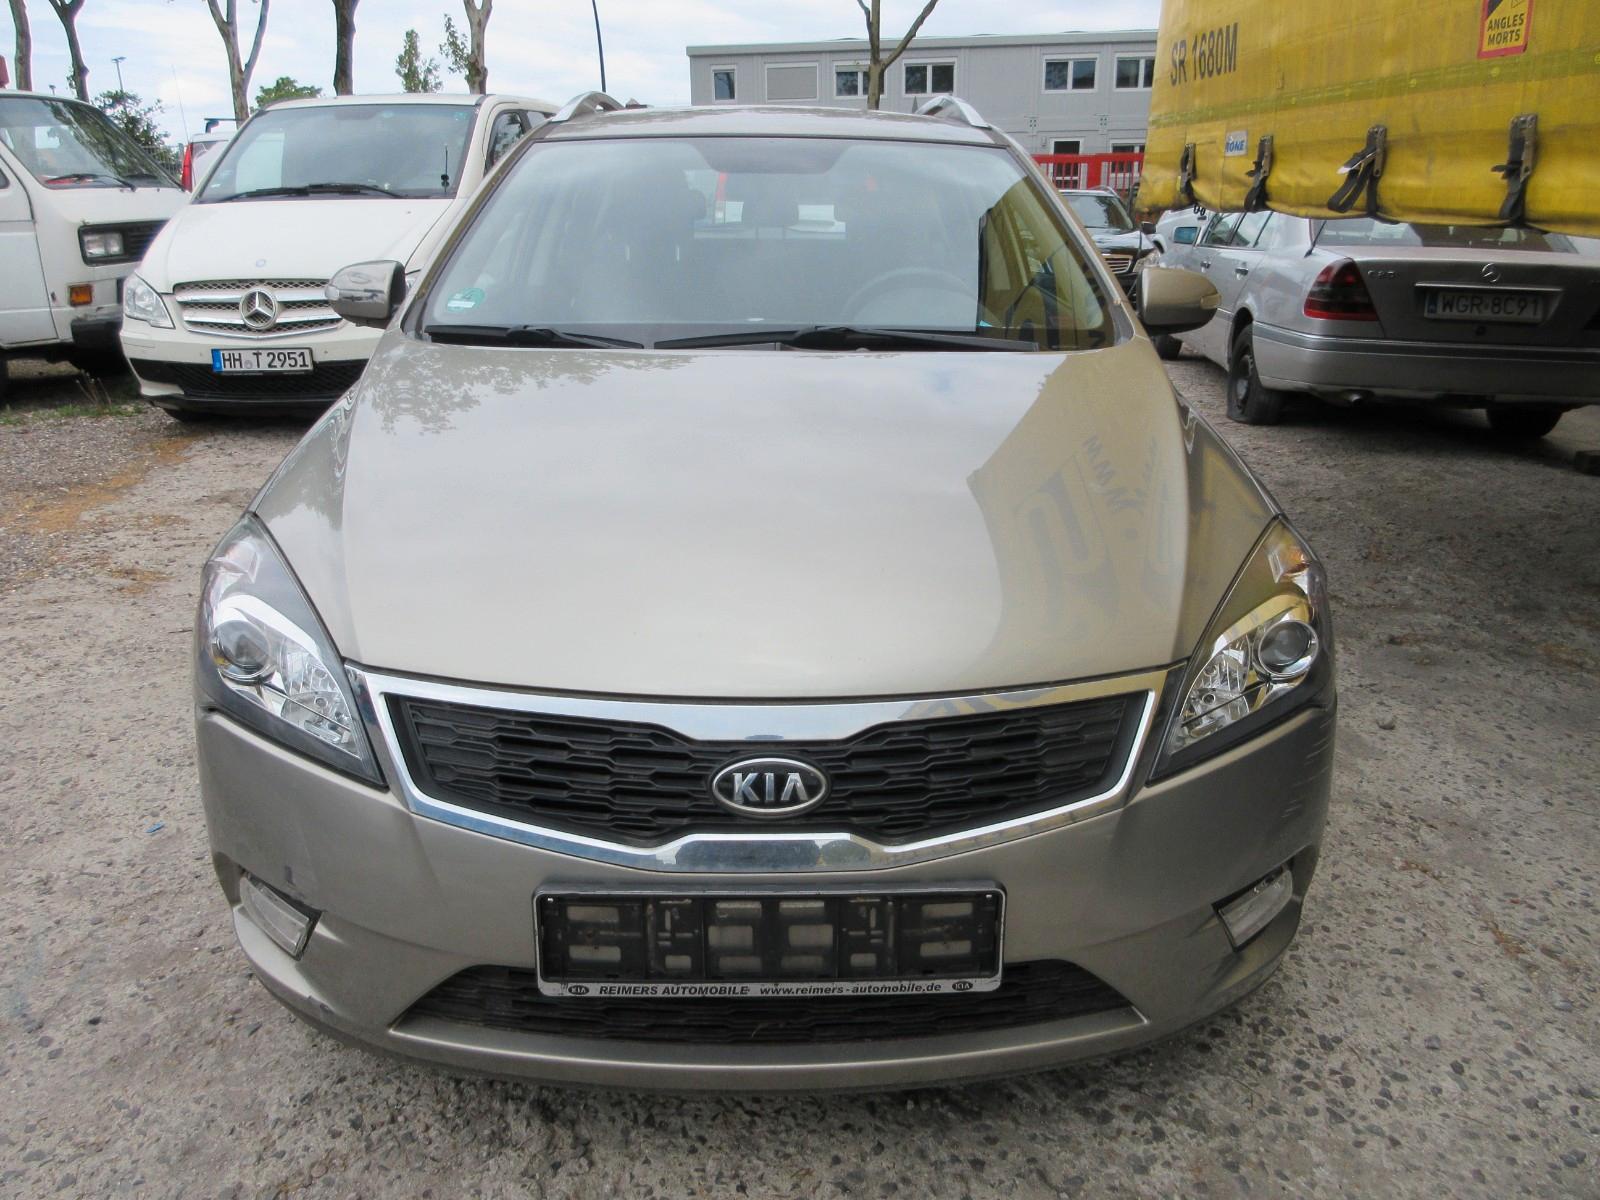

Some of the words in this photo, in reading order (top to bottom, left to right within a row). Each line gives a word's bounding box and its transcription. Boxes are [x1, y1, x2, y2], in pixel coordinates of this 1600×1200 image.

[1487, 13, 1525, 32] ANGLES
[1487, 29, 1521, 46] MORTS
[1170, 39, 1187, 87] SR
[1192, 22, 1238, 80] 1680M
[1441, 296, 1484, 314] WGR
[222, 352, 243, 369] HH
[252, 351, 262, 369] T
[267, 352, 309, 369] 2951
[732, 773, 808, 801] KIA
[570, 986, 587, 994] KIA
[599, 985, 658, 995] REIMERS
[662, 985, 749, 995] AUTOMOBILE
[760, 982, 941, 995] www.reimers-automobile.de
[953, 982, 972, 991] KIA
